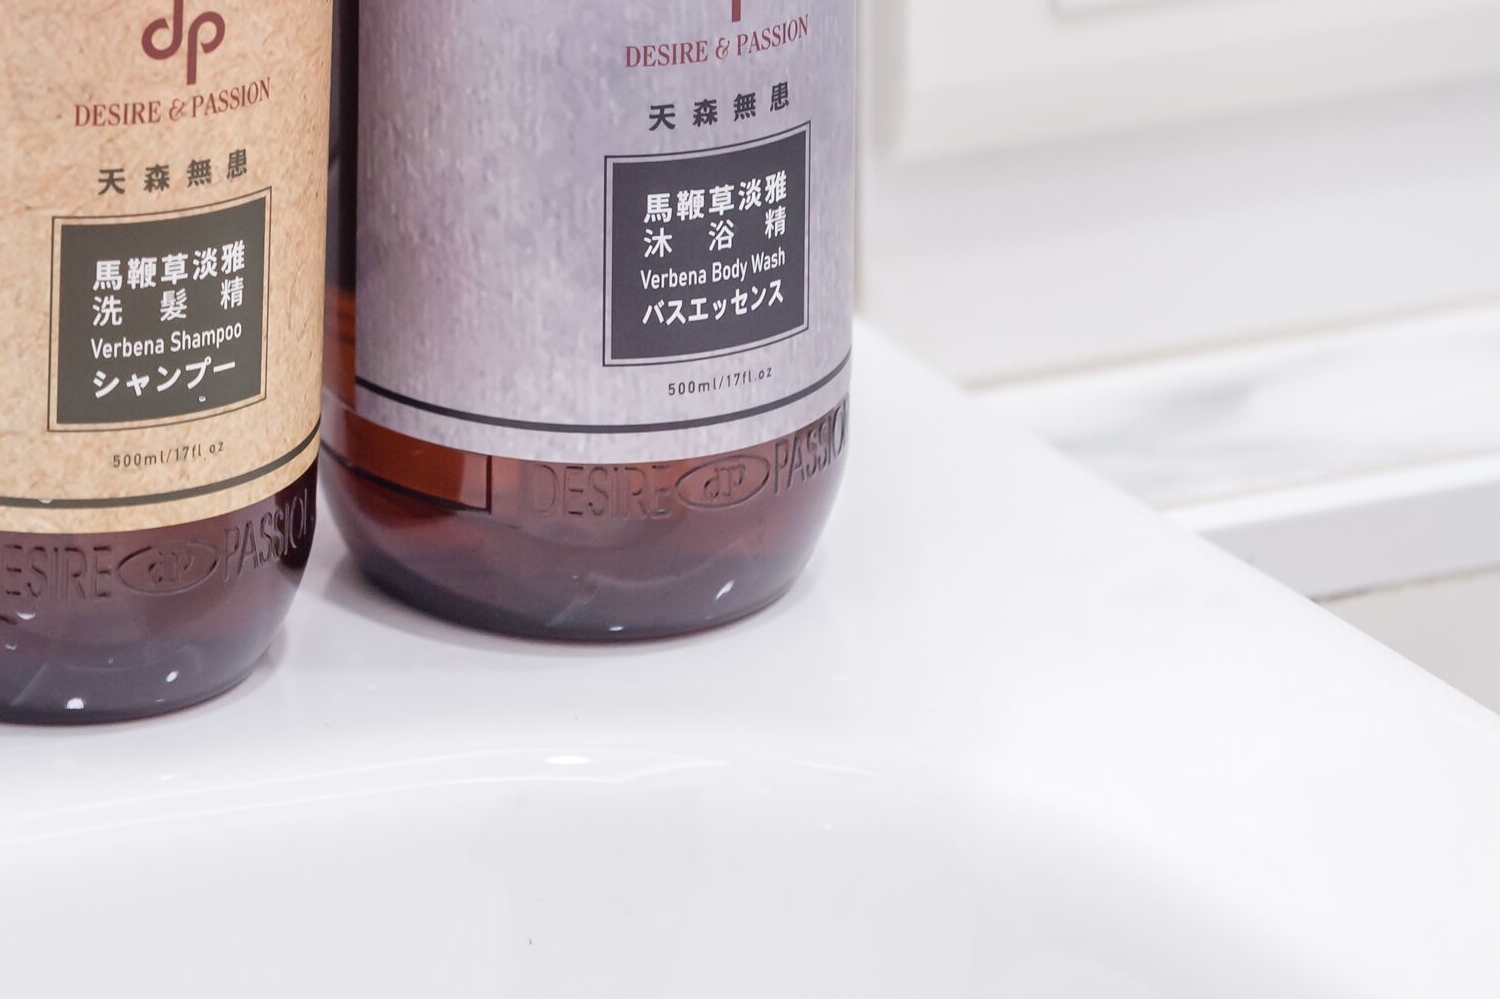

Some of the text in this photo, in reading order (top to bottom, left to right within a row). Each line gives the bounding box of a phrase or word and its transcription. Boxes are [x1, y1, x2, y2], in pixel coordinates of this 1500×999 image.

[625, 13, 809, 68] DESIRE & PASSION
[74, 76, 271, 128] DESIRE & PASSION
[643, 170, 787, 224] 馬鞭草淡雅
[92, 239, 245, 291] 馬鞭草淡雅
[640, 247, 786, 290] Verbena Body Wash
[642, 279, 784, 326] バスエッセンス
[91, 322, 242, 360] Verbena Shampoo
[93, 356, 236, 399] シャンプー
